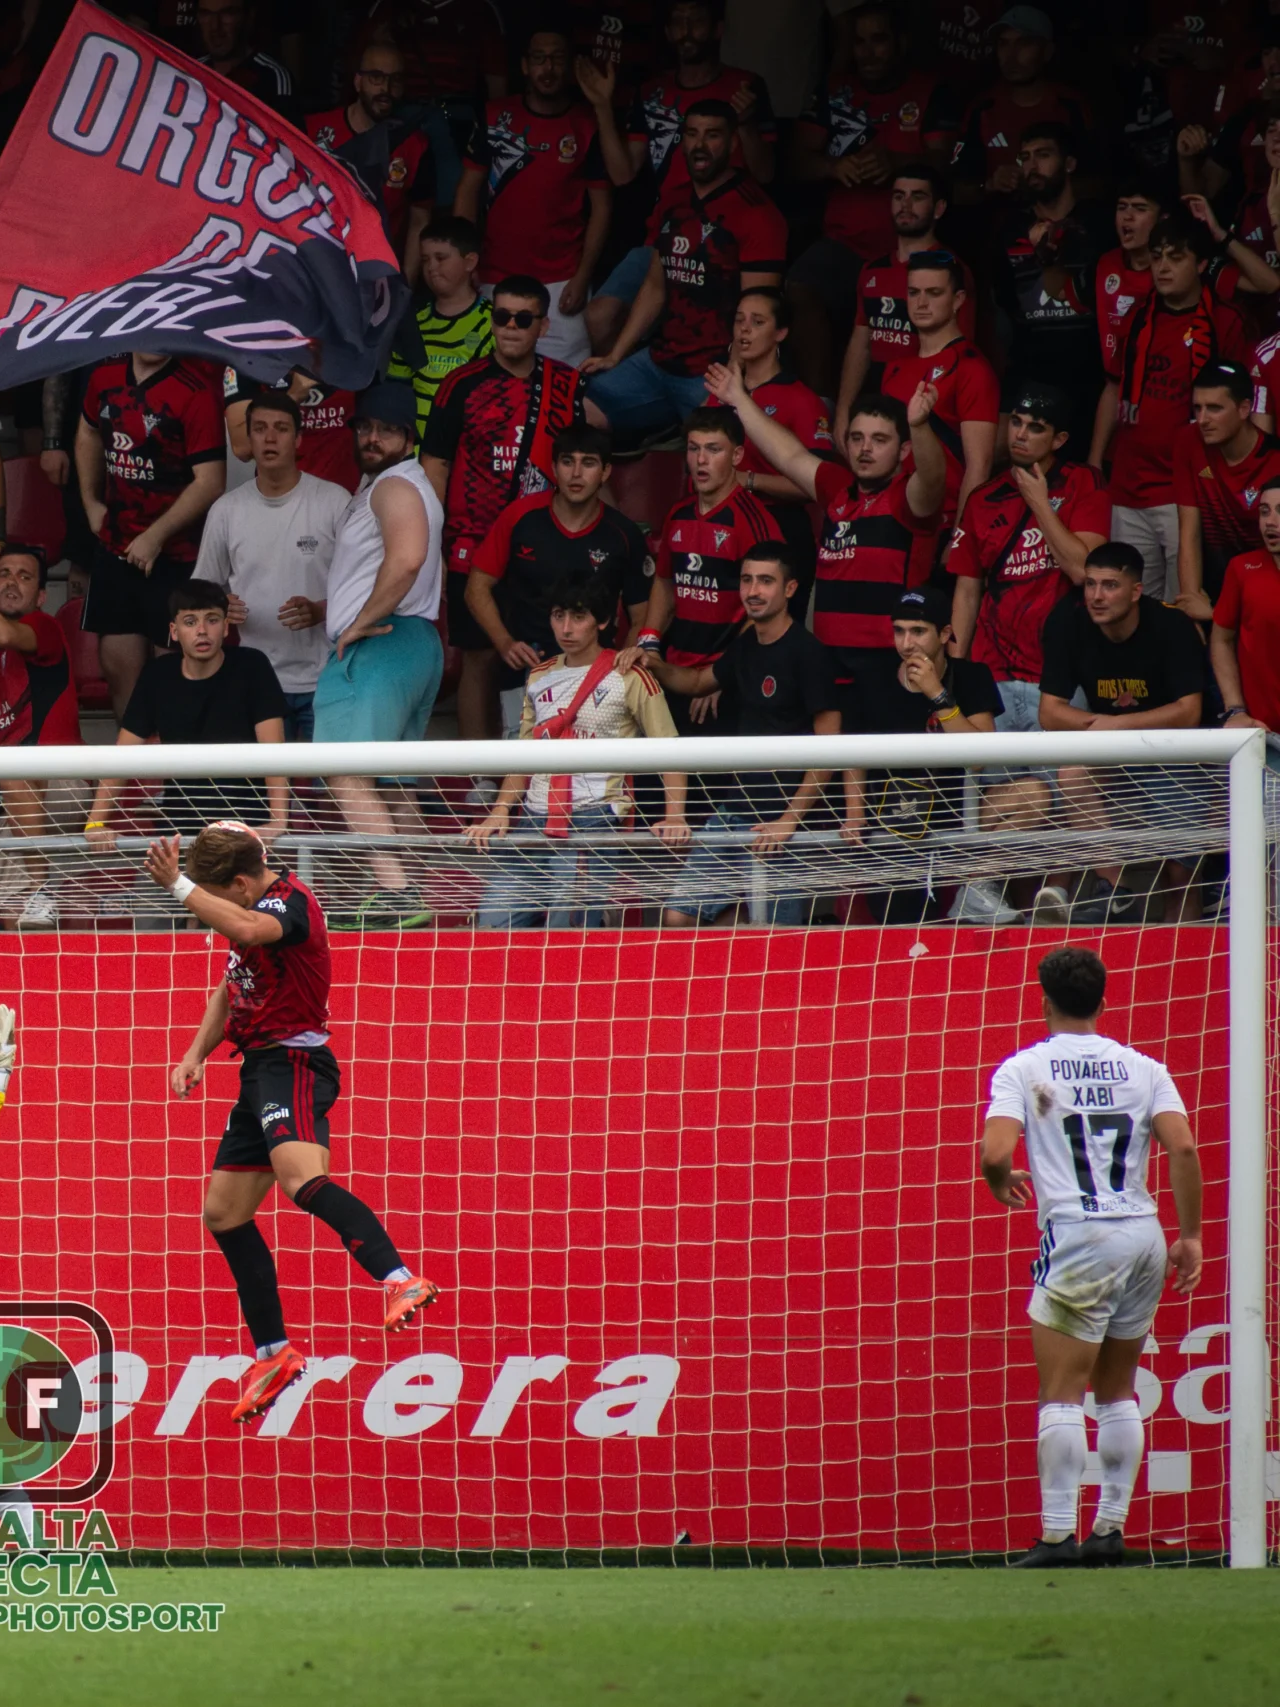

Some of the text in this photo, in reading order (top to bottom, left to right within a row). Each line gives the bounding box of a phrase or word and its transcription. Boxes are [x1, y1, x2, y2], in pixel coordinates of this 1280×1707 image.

[142, 213, 298, 284] DE
[1050, 1060, 1130, 1082] POVARELO
[1073, 1086, 1114, 1107] XABI
[1062, 1113, 1134, 1196] 17
